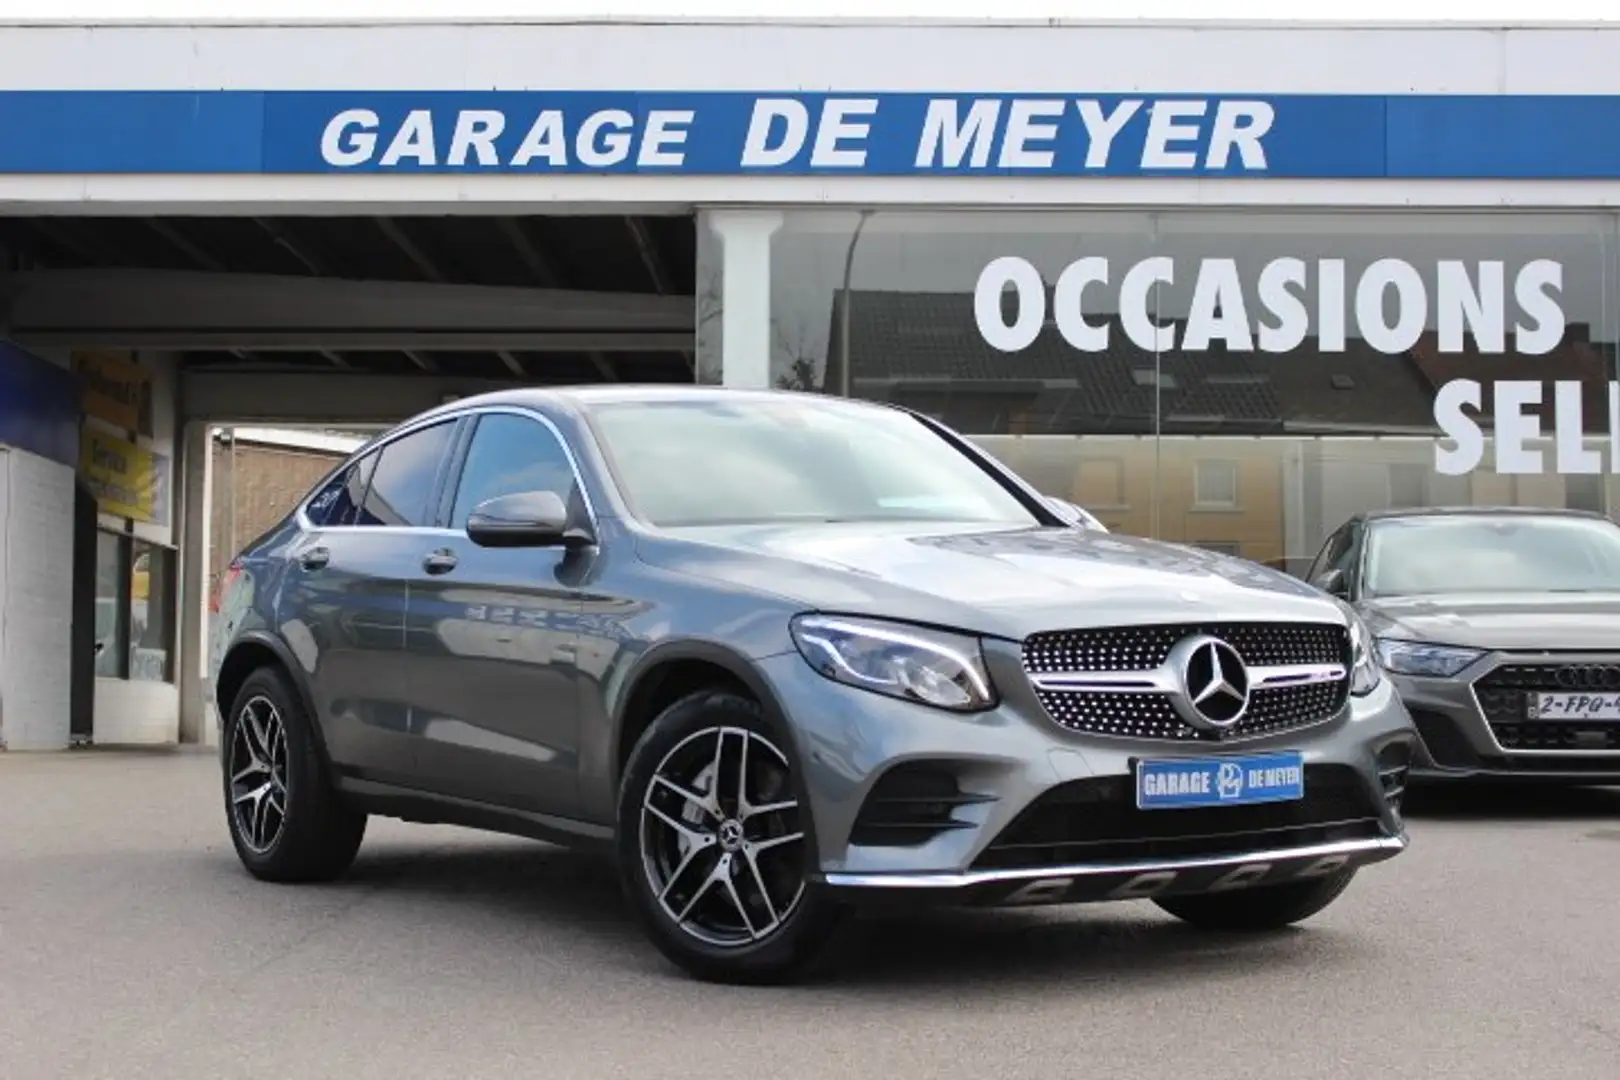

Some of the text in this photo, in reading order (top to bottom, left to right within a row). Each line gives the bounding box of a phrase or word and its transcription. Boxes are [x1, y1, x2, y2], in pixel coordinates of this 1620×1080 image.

[320, 98, 1275, 170] GARAGE DE MEYER
[974, 256, 1565, 354] OCCASIONS
[1433, 378, 1620, 476] SEL
[1144, 771, 1210, 796] GARAGE
[1249, 769, 1264, 789] DE
[1264, 766, 1300, 787] MEYER
